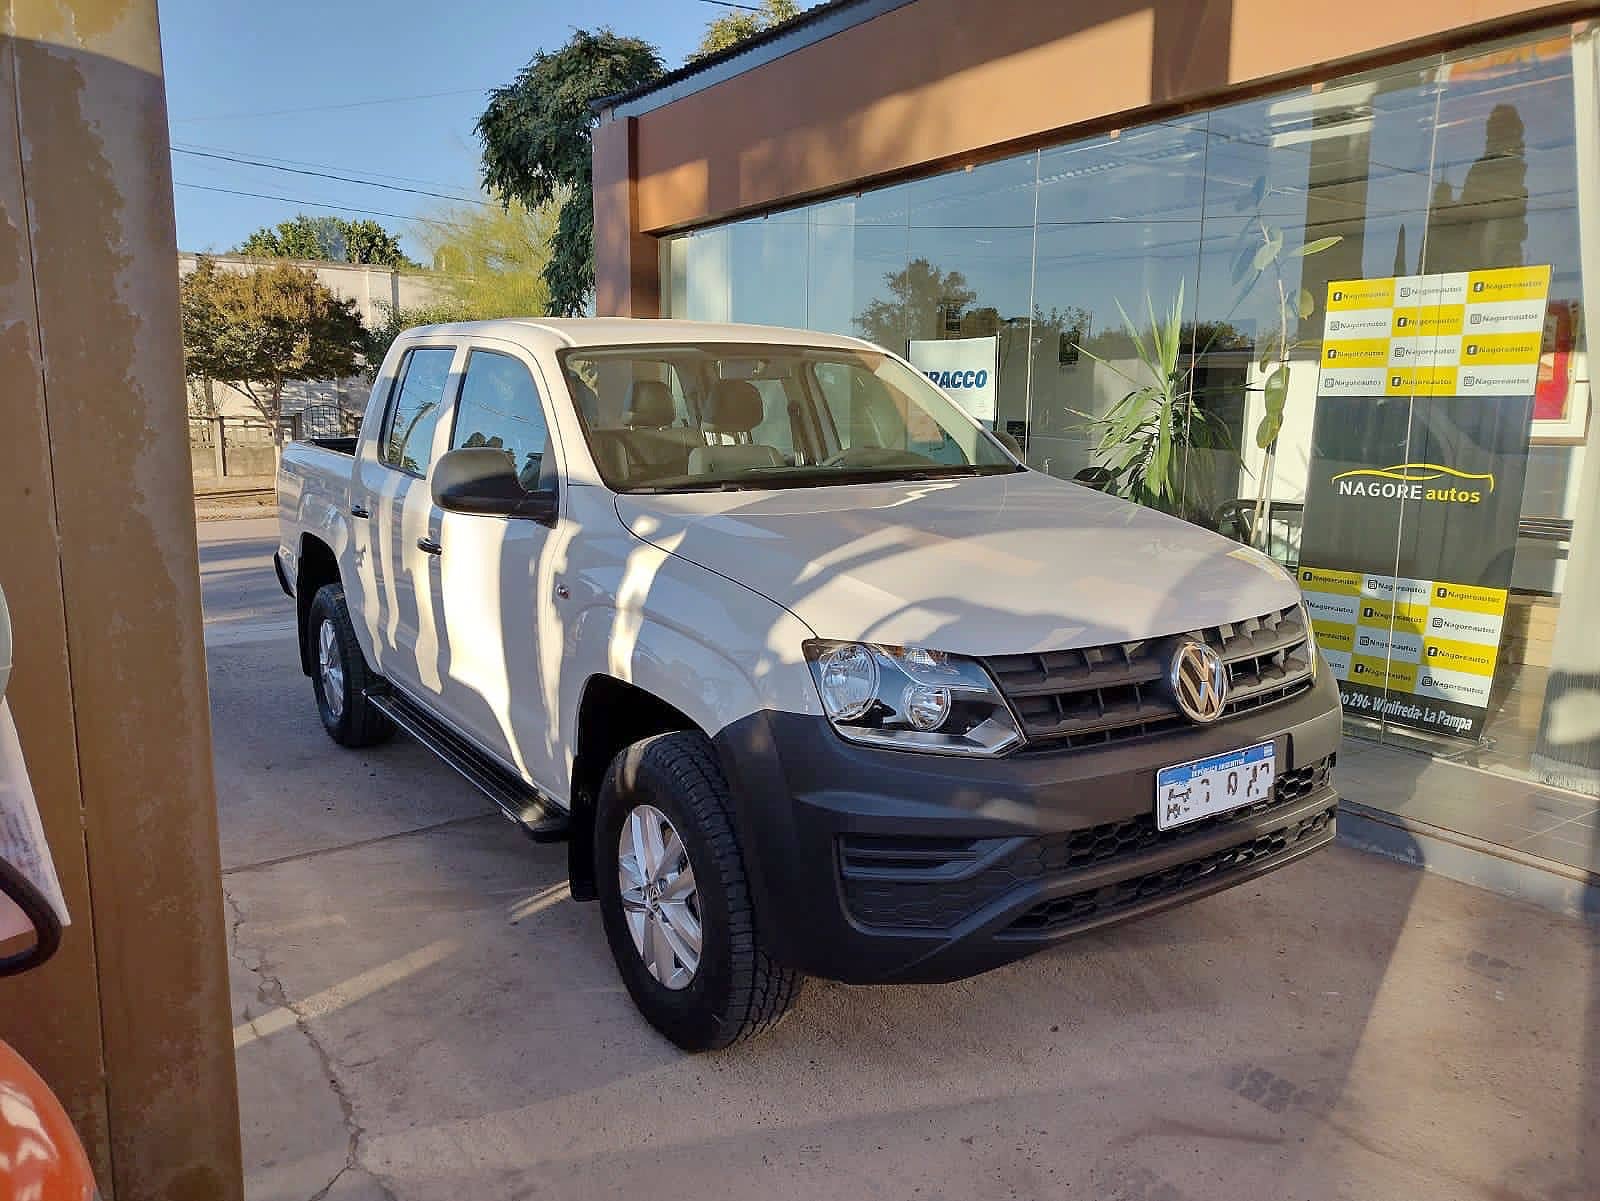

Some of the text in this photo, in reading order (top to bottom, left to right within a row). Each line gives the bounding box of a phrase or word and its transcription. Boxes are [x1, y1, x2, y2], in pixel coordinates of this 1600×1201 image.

[1339, 481, 1481, 504] NAGORE autos
[1423, 709, 1438, 723] La
[1438, 710, 1474, 733] Pampa
